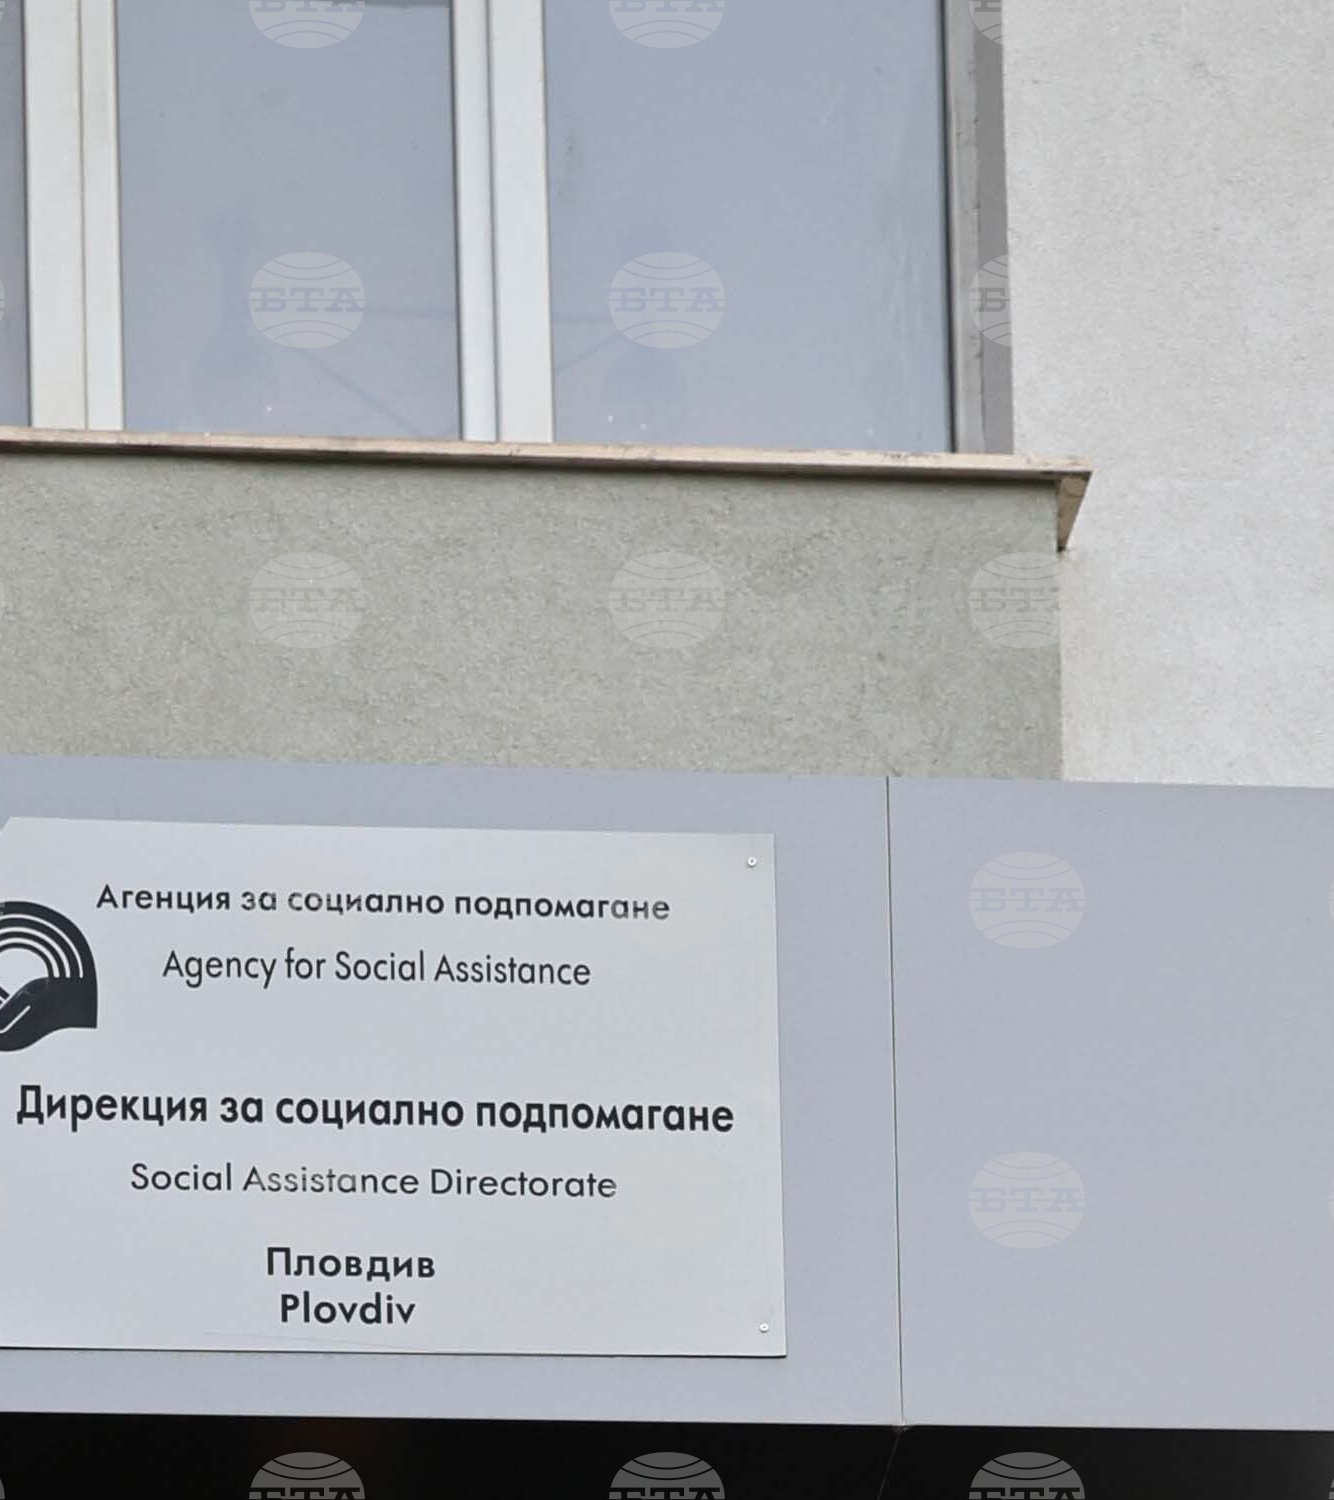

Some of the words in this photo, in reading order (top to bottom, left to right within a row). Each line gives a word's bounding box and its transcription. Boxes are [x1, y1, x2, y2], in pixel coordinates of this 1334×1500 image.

[96, 883, 232, 916] Агенция
[240, 889, 278, 914] за
[286, 889, 446, 920] социално
[454, 890, 671, 923] подпомагане
[162, 950, 277, 989] Agency
[283, 949, 326, 983] for
[334, 950, 426, 985] Social
[434, 953, 592, 988] Assistance
[16, 1084, 209, 1133] Дирекция
[218, 1091, 265, 1126] за
[275, 1096, 465, 1132] социално
[475, 1096, 735, 1138] подпомагане
[130, 1163, 233, 1195] Social
[242, 1165, 420, 1198] Assistance
[430, 1168, 618, 1201] Directorate
[265, 1246, 437, 1285] Пловдив
[280, 1291, 417, 1328] Plovdiv
